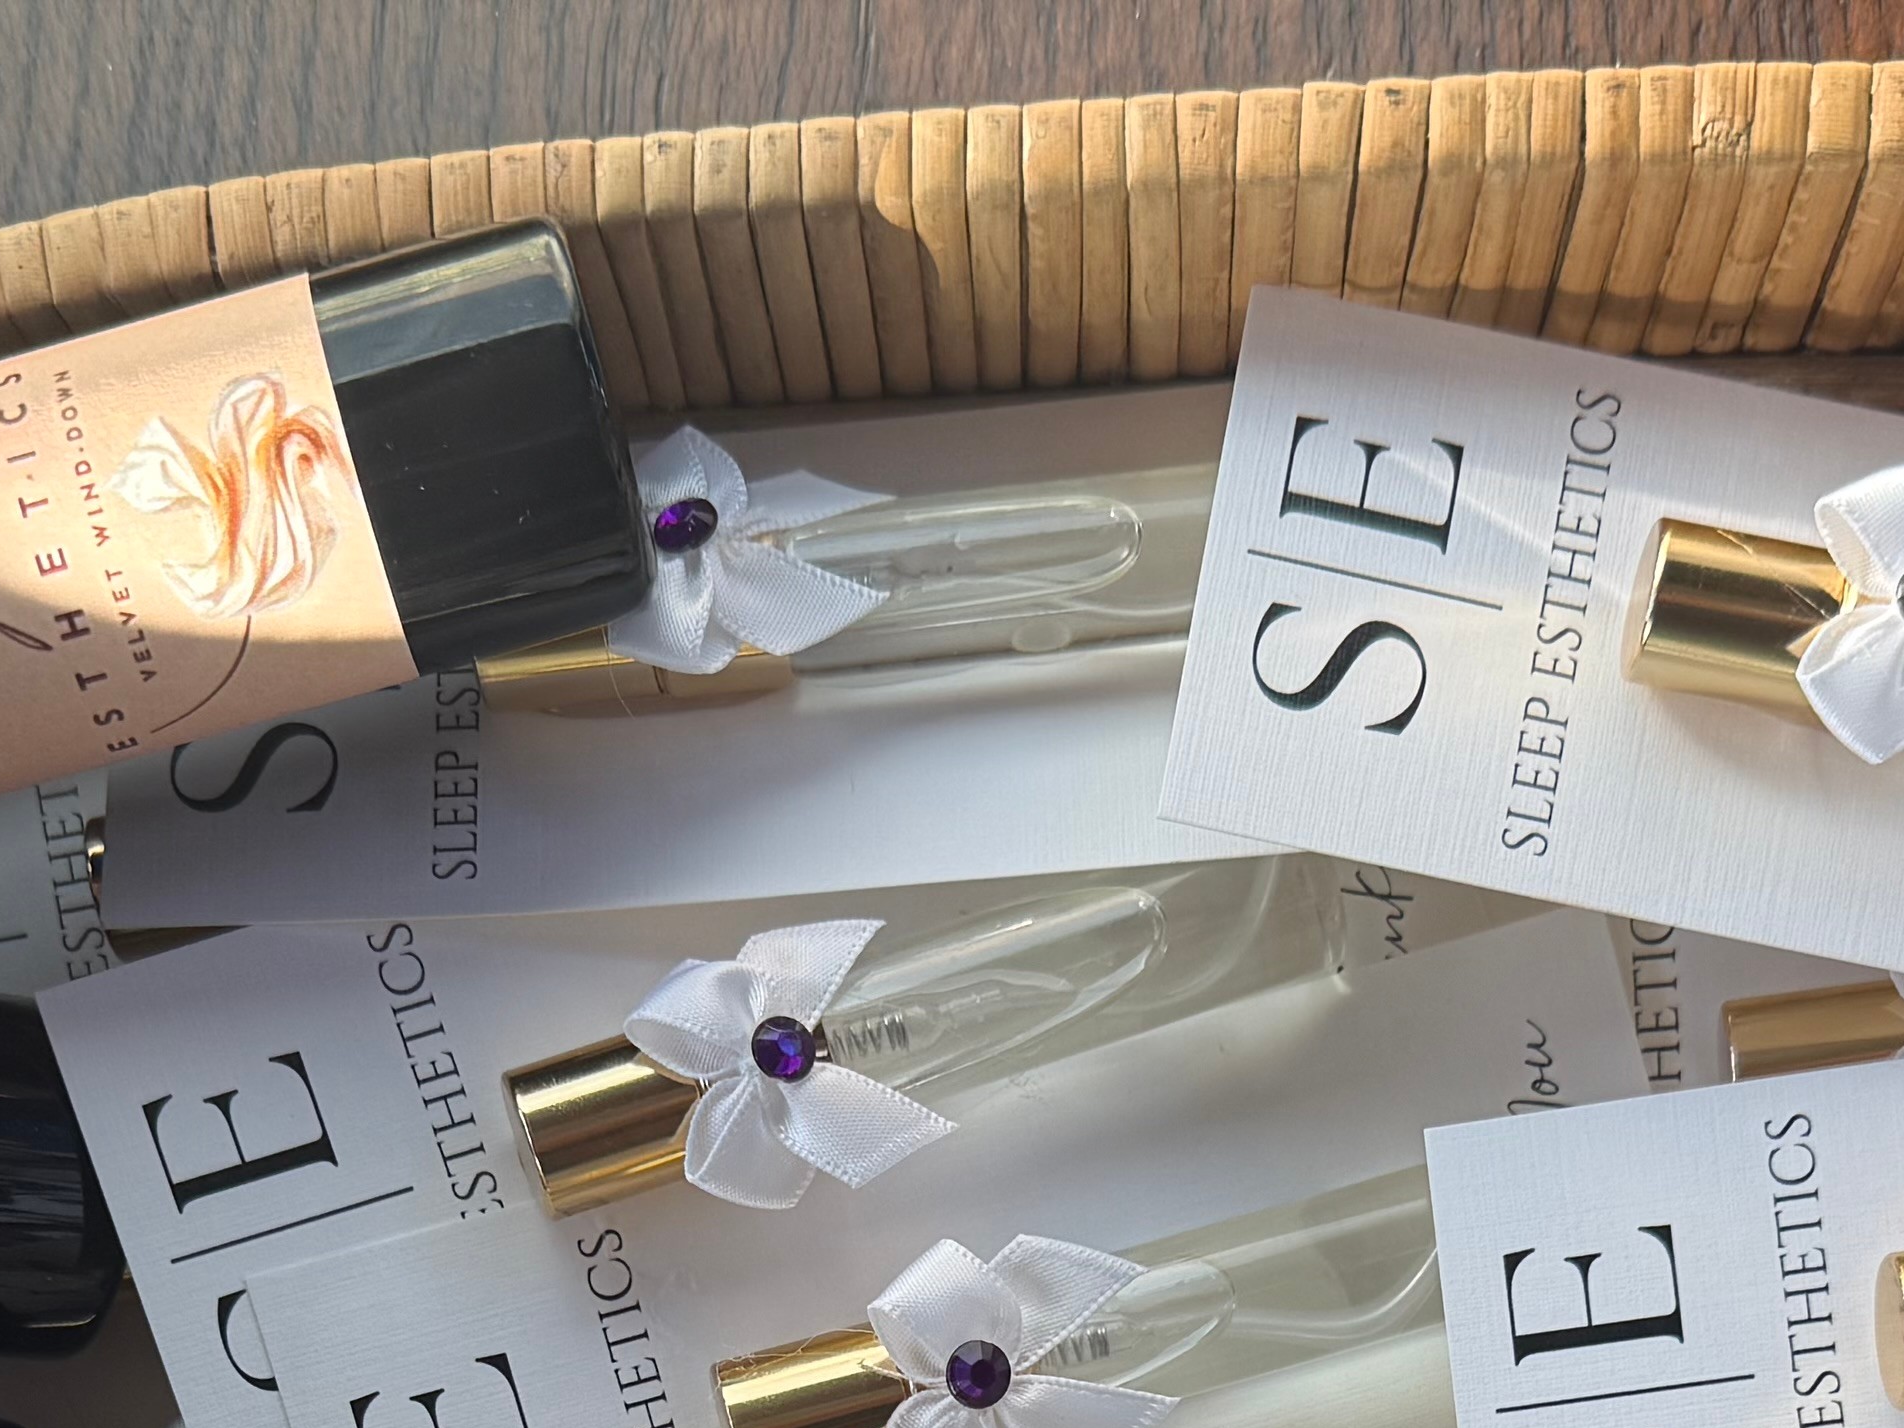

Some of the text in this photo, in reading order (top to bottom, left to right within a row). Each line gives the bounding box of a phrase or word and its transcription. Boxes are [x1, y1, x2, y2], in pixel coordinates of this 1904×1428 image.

[104, 566, 159, 682] VELVET
[1501, 387, 1623, 856] SLEEP ESTHETICS
[430, 750, 483, 881] SLEEP
